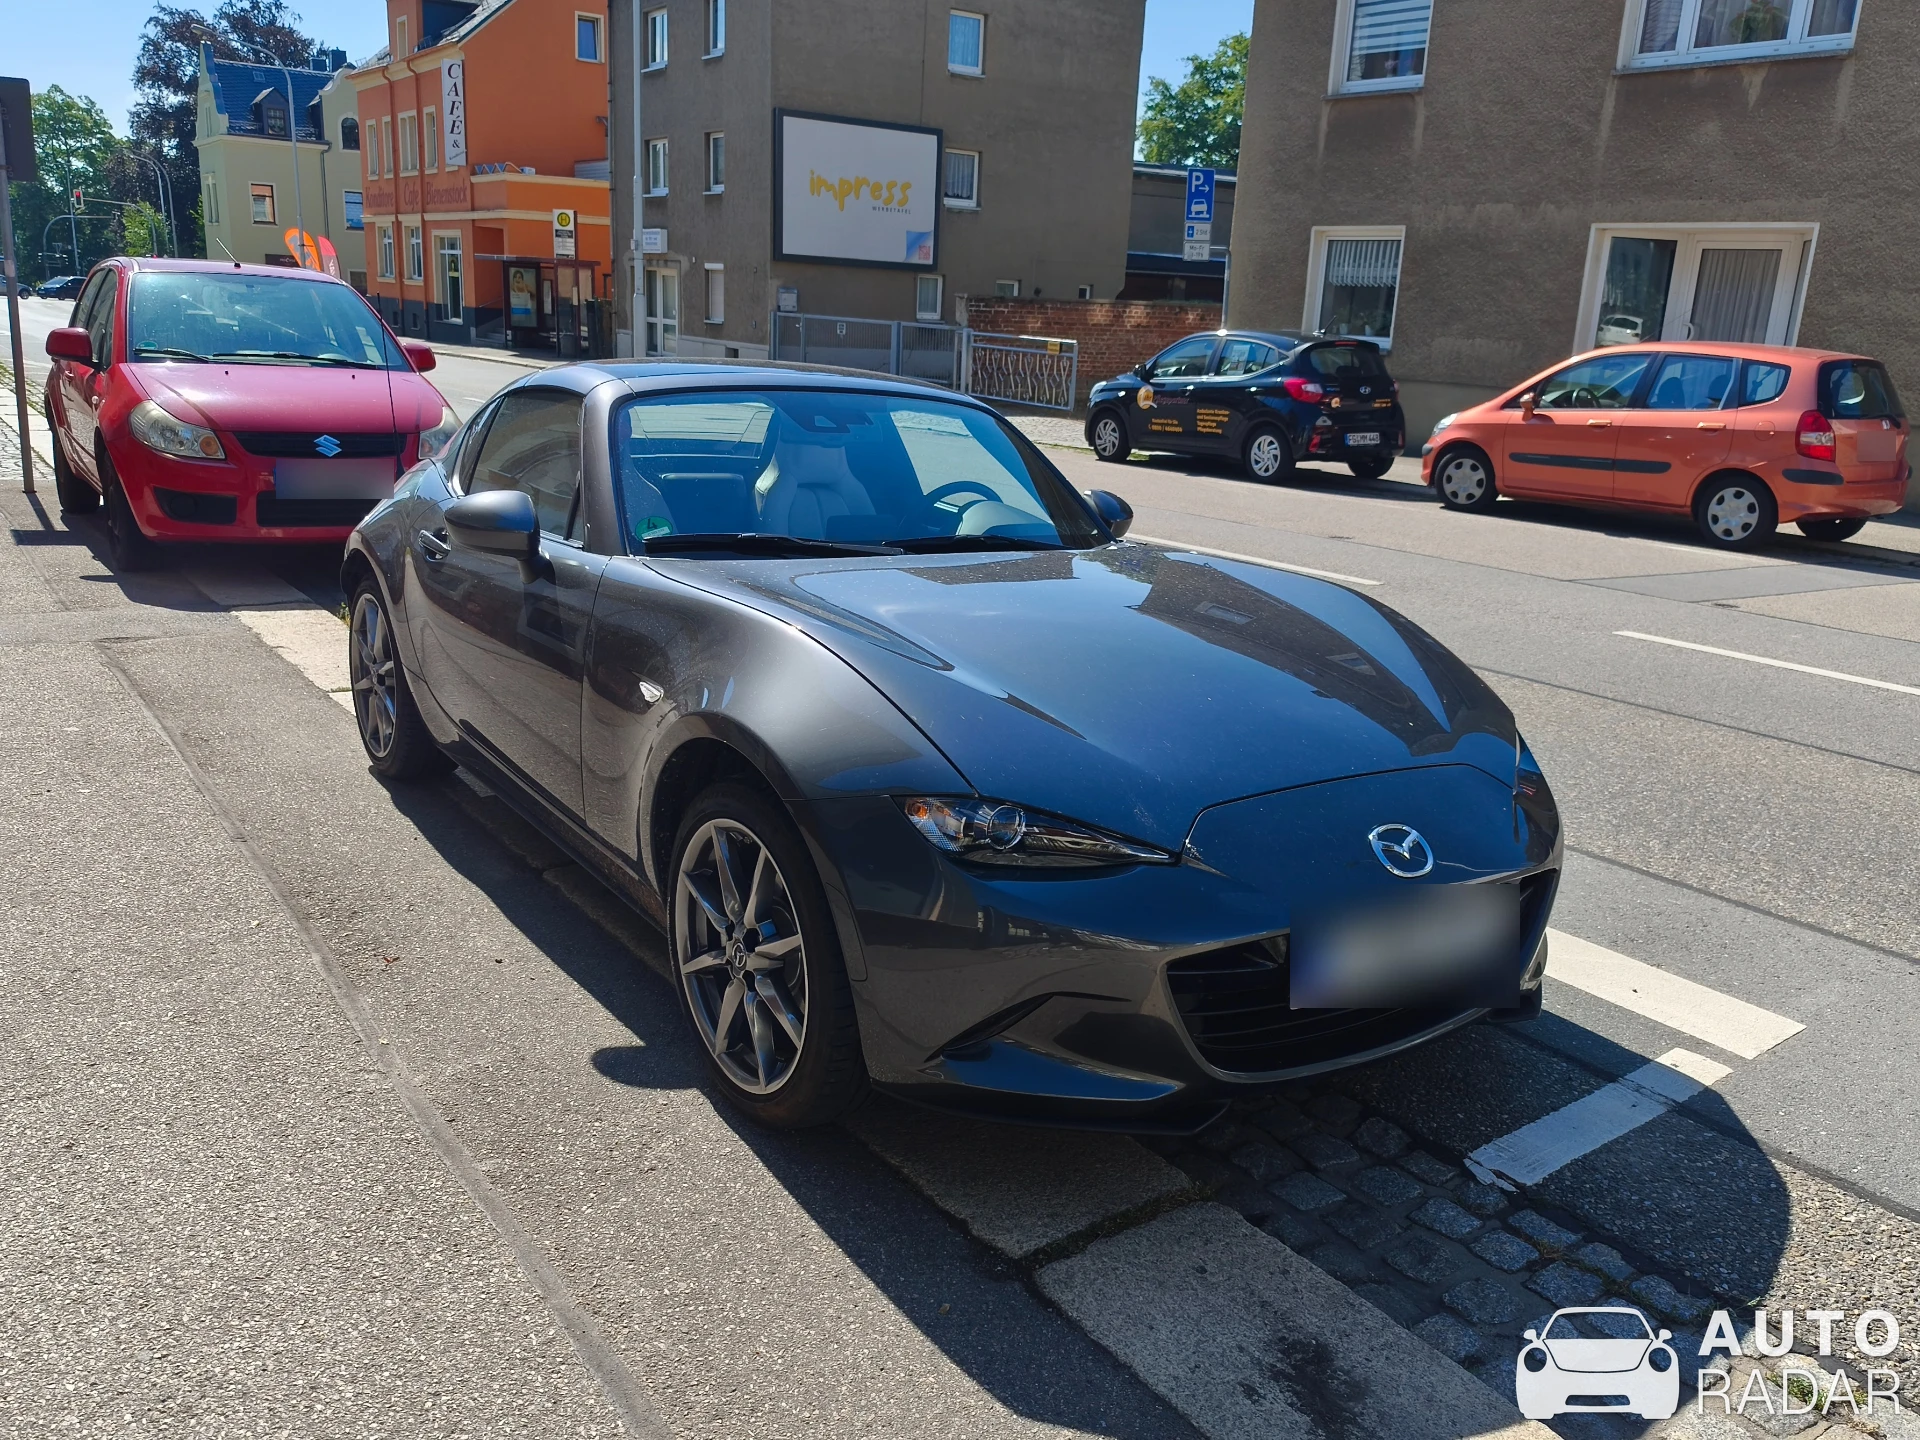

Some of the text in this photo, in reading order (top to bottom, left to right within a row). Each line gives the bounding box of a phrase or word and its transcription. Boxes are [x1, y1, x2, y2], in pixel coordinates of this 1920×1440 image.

[447, 63, 463, 135] CAFÉ
[452, 139, 460, 149] &
[426, 178, 468, 206] Bienenstock
[809, 169, 912, 212] impress
[1192, 172, 1204, 192] P
[872, 206, 912, 215] WERBETAFEL
[647, 518, 657, 529] 4
